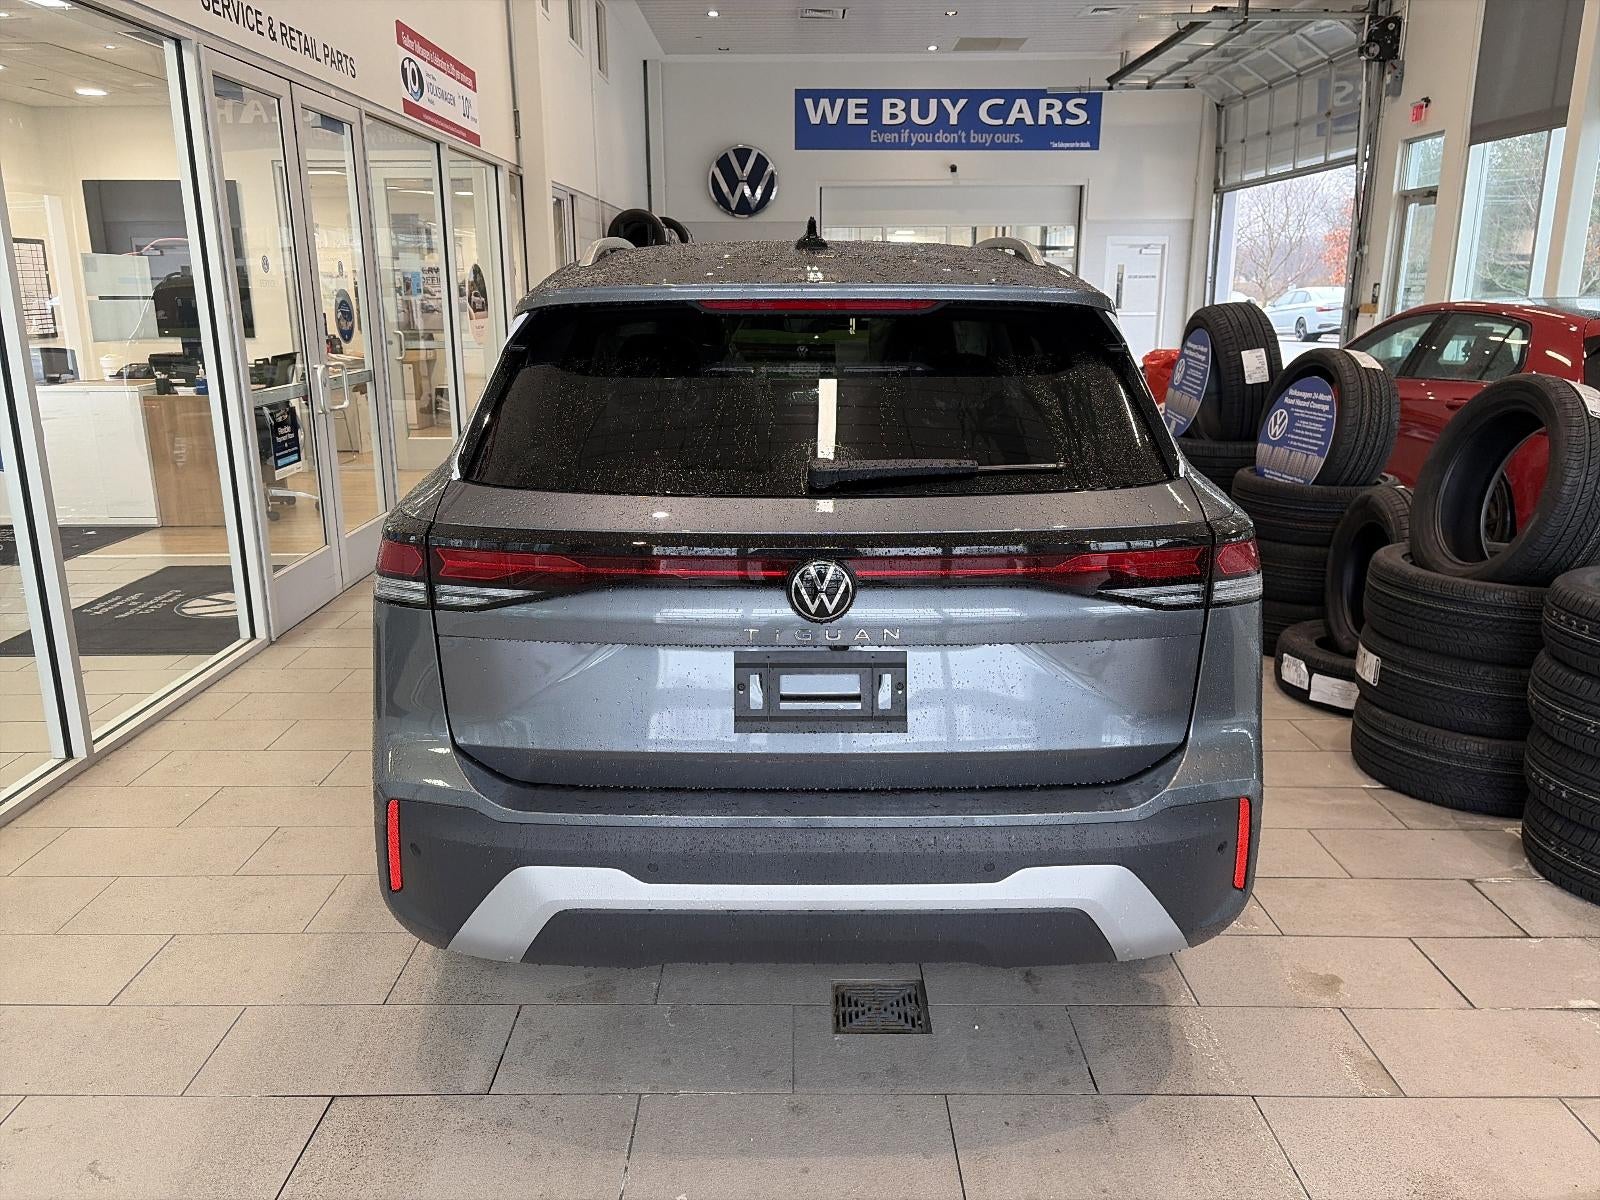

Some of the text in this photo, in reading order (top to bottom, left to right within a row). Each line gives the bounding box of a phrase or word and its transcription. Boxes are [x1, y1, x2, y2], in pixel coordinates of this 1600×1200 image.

[267, 16, 277, 43] &
[280, 22, 321, 63] RETAIL
[323, 43, 356, 79] PARTS
[426, 80, 456, 107] VOLKSWAGEN
[803, 98, 1091, 126] WE BUY CARS.
[870, 129, 1024, 146] Even if you don't buy ours.
[1284, 396, 1330, 412] Road Hazard Coverage
[1288, 388, 1313, 400] Volkswagen
